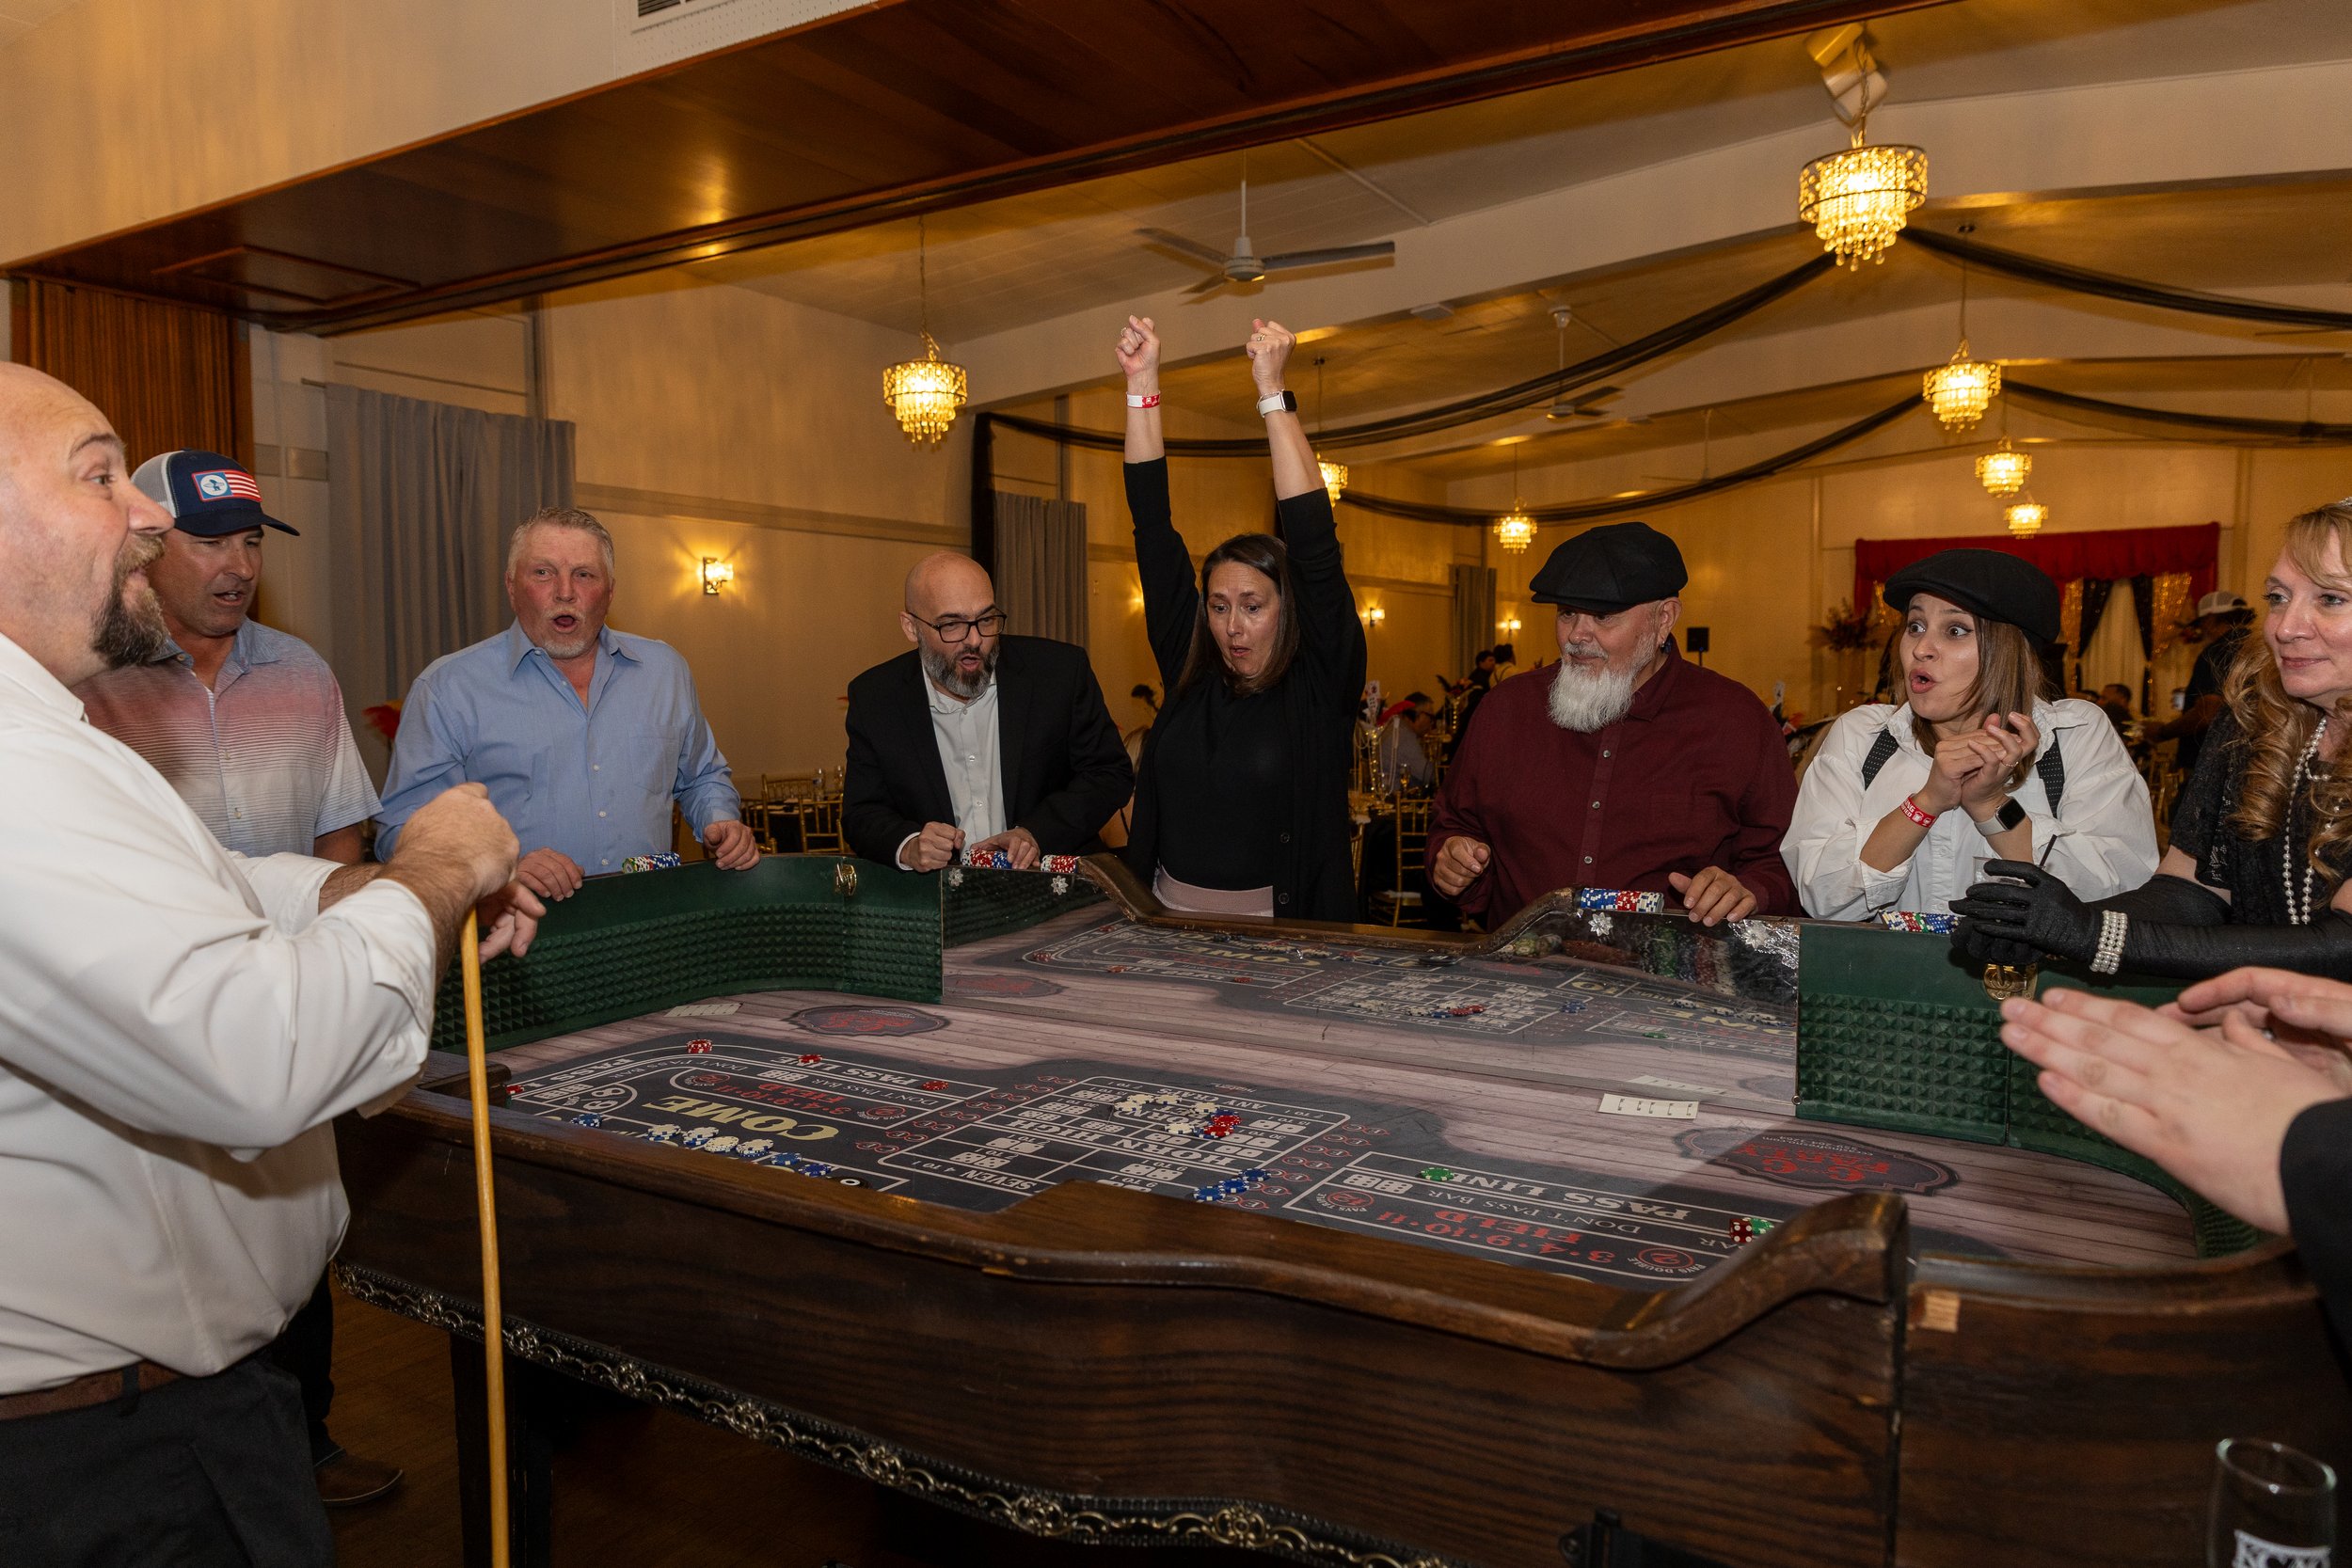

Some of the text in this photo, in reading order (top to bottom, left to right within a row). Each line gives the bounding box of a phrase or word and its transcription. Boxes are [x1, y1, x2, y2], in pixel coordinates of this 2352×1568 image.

[550, 1058, 635, 1082] PASS
[842, 1068, 921, 1085] PASS
[591, 1087, 626, 1098] 8
[758, 1083, 846, 1103] FIELD
[812, 1078, 939, 1105] DON'T PASS BAR
[1157, 1087, 1219, 1101] CRAPS
[1223, 1099, 1267, 1111] ANY
[642, 1095, 840, 1140] COME
[1126, 1110, 1208, 1127] HORN
[1006, 1119, 1237, 1165] HORN HIGH
[1733, 1143, 1891, 1175] PARTY
[959, 1169, 1038, 1190] SEVEN
[1449, 1172, 1691, 1220] PASS LINE
[1428, 1189, 1641, 1234] DON'T PASS BAR
[1435, 1210, 1582, 1243] FIELD
[1628, 1257, 1707, 1274] PAYS DOUBLE
